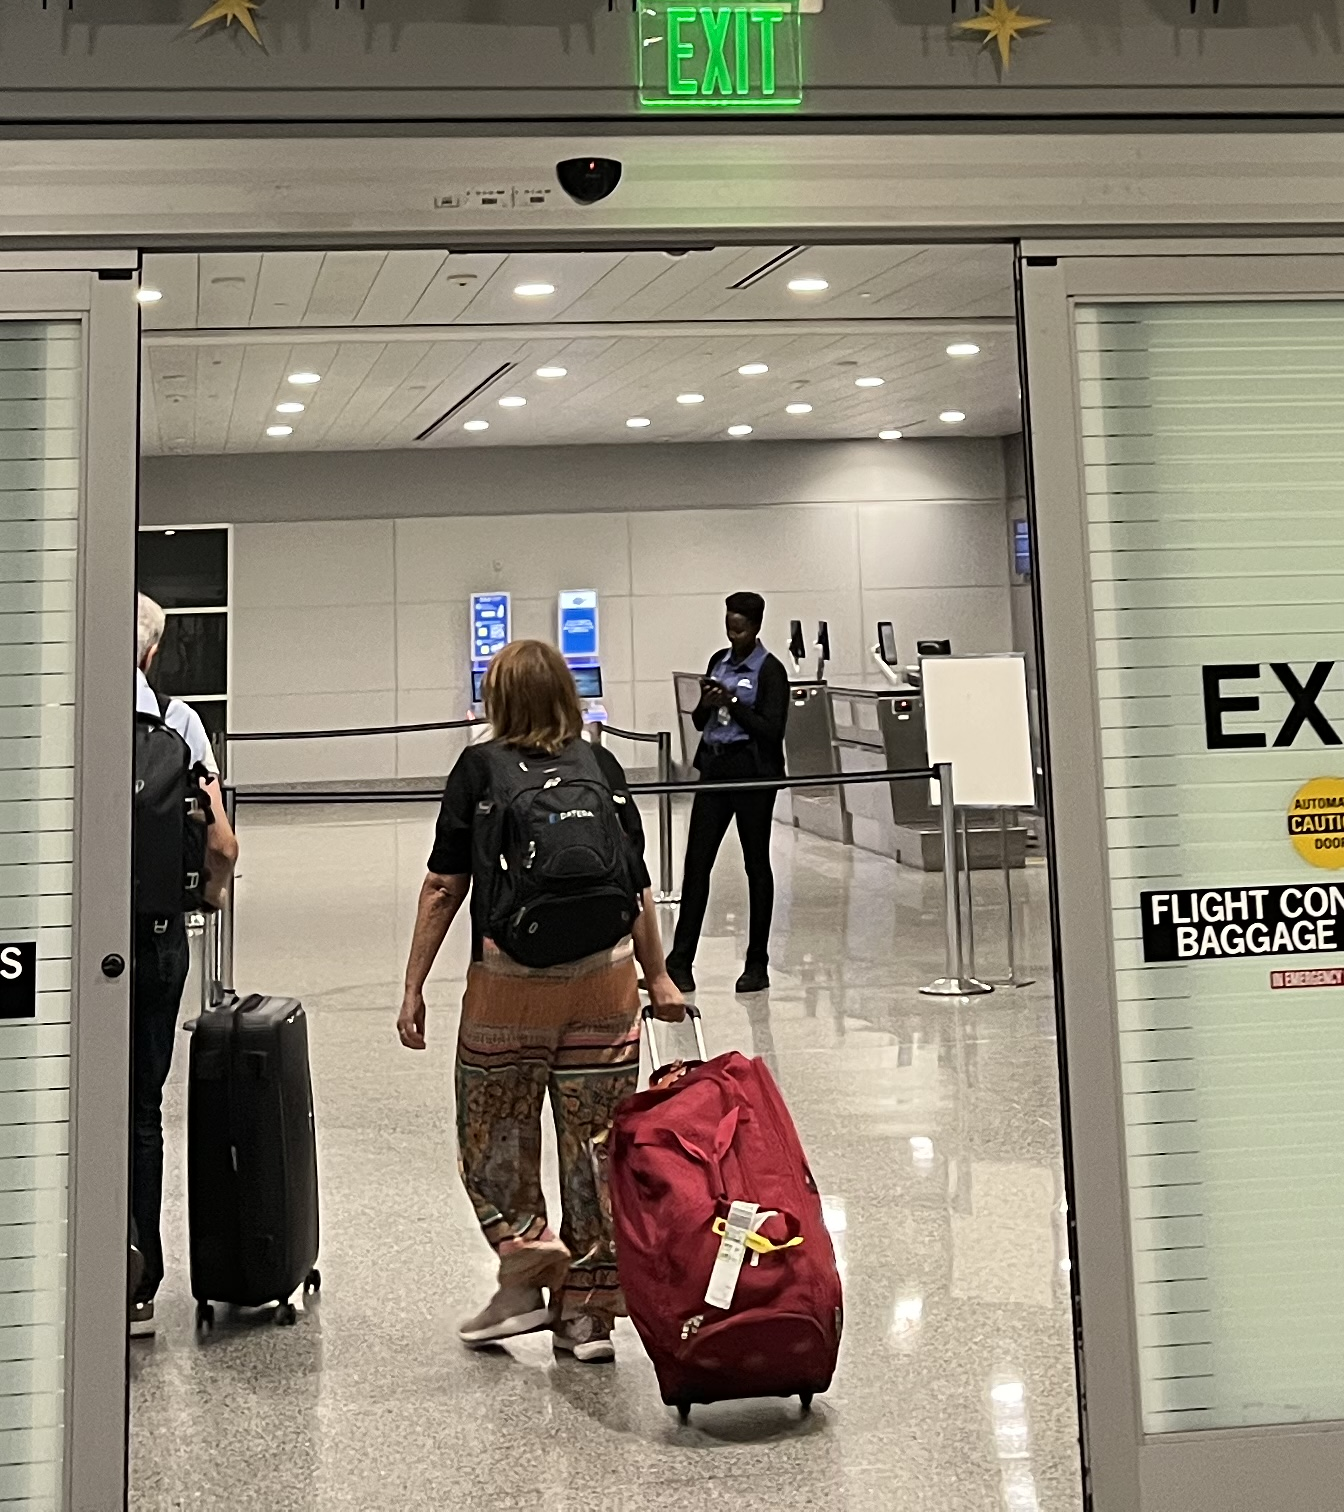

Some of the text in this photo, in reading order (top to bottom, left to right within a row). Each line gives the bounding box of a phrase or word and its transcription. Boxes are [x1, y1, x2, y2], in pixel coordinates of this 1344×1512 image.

[666, 5, 781, 96] EXIT
[1151, 889, 1270, 925] FLIGHT
[1176, 918, 1338, 957] BAGGAGE
